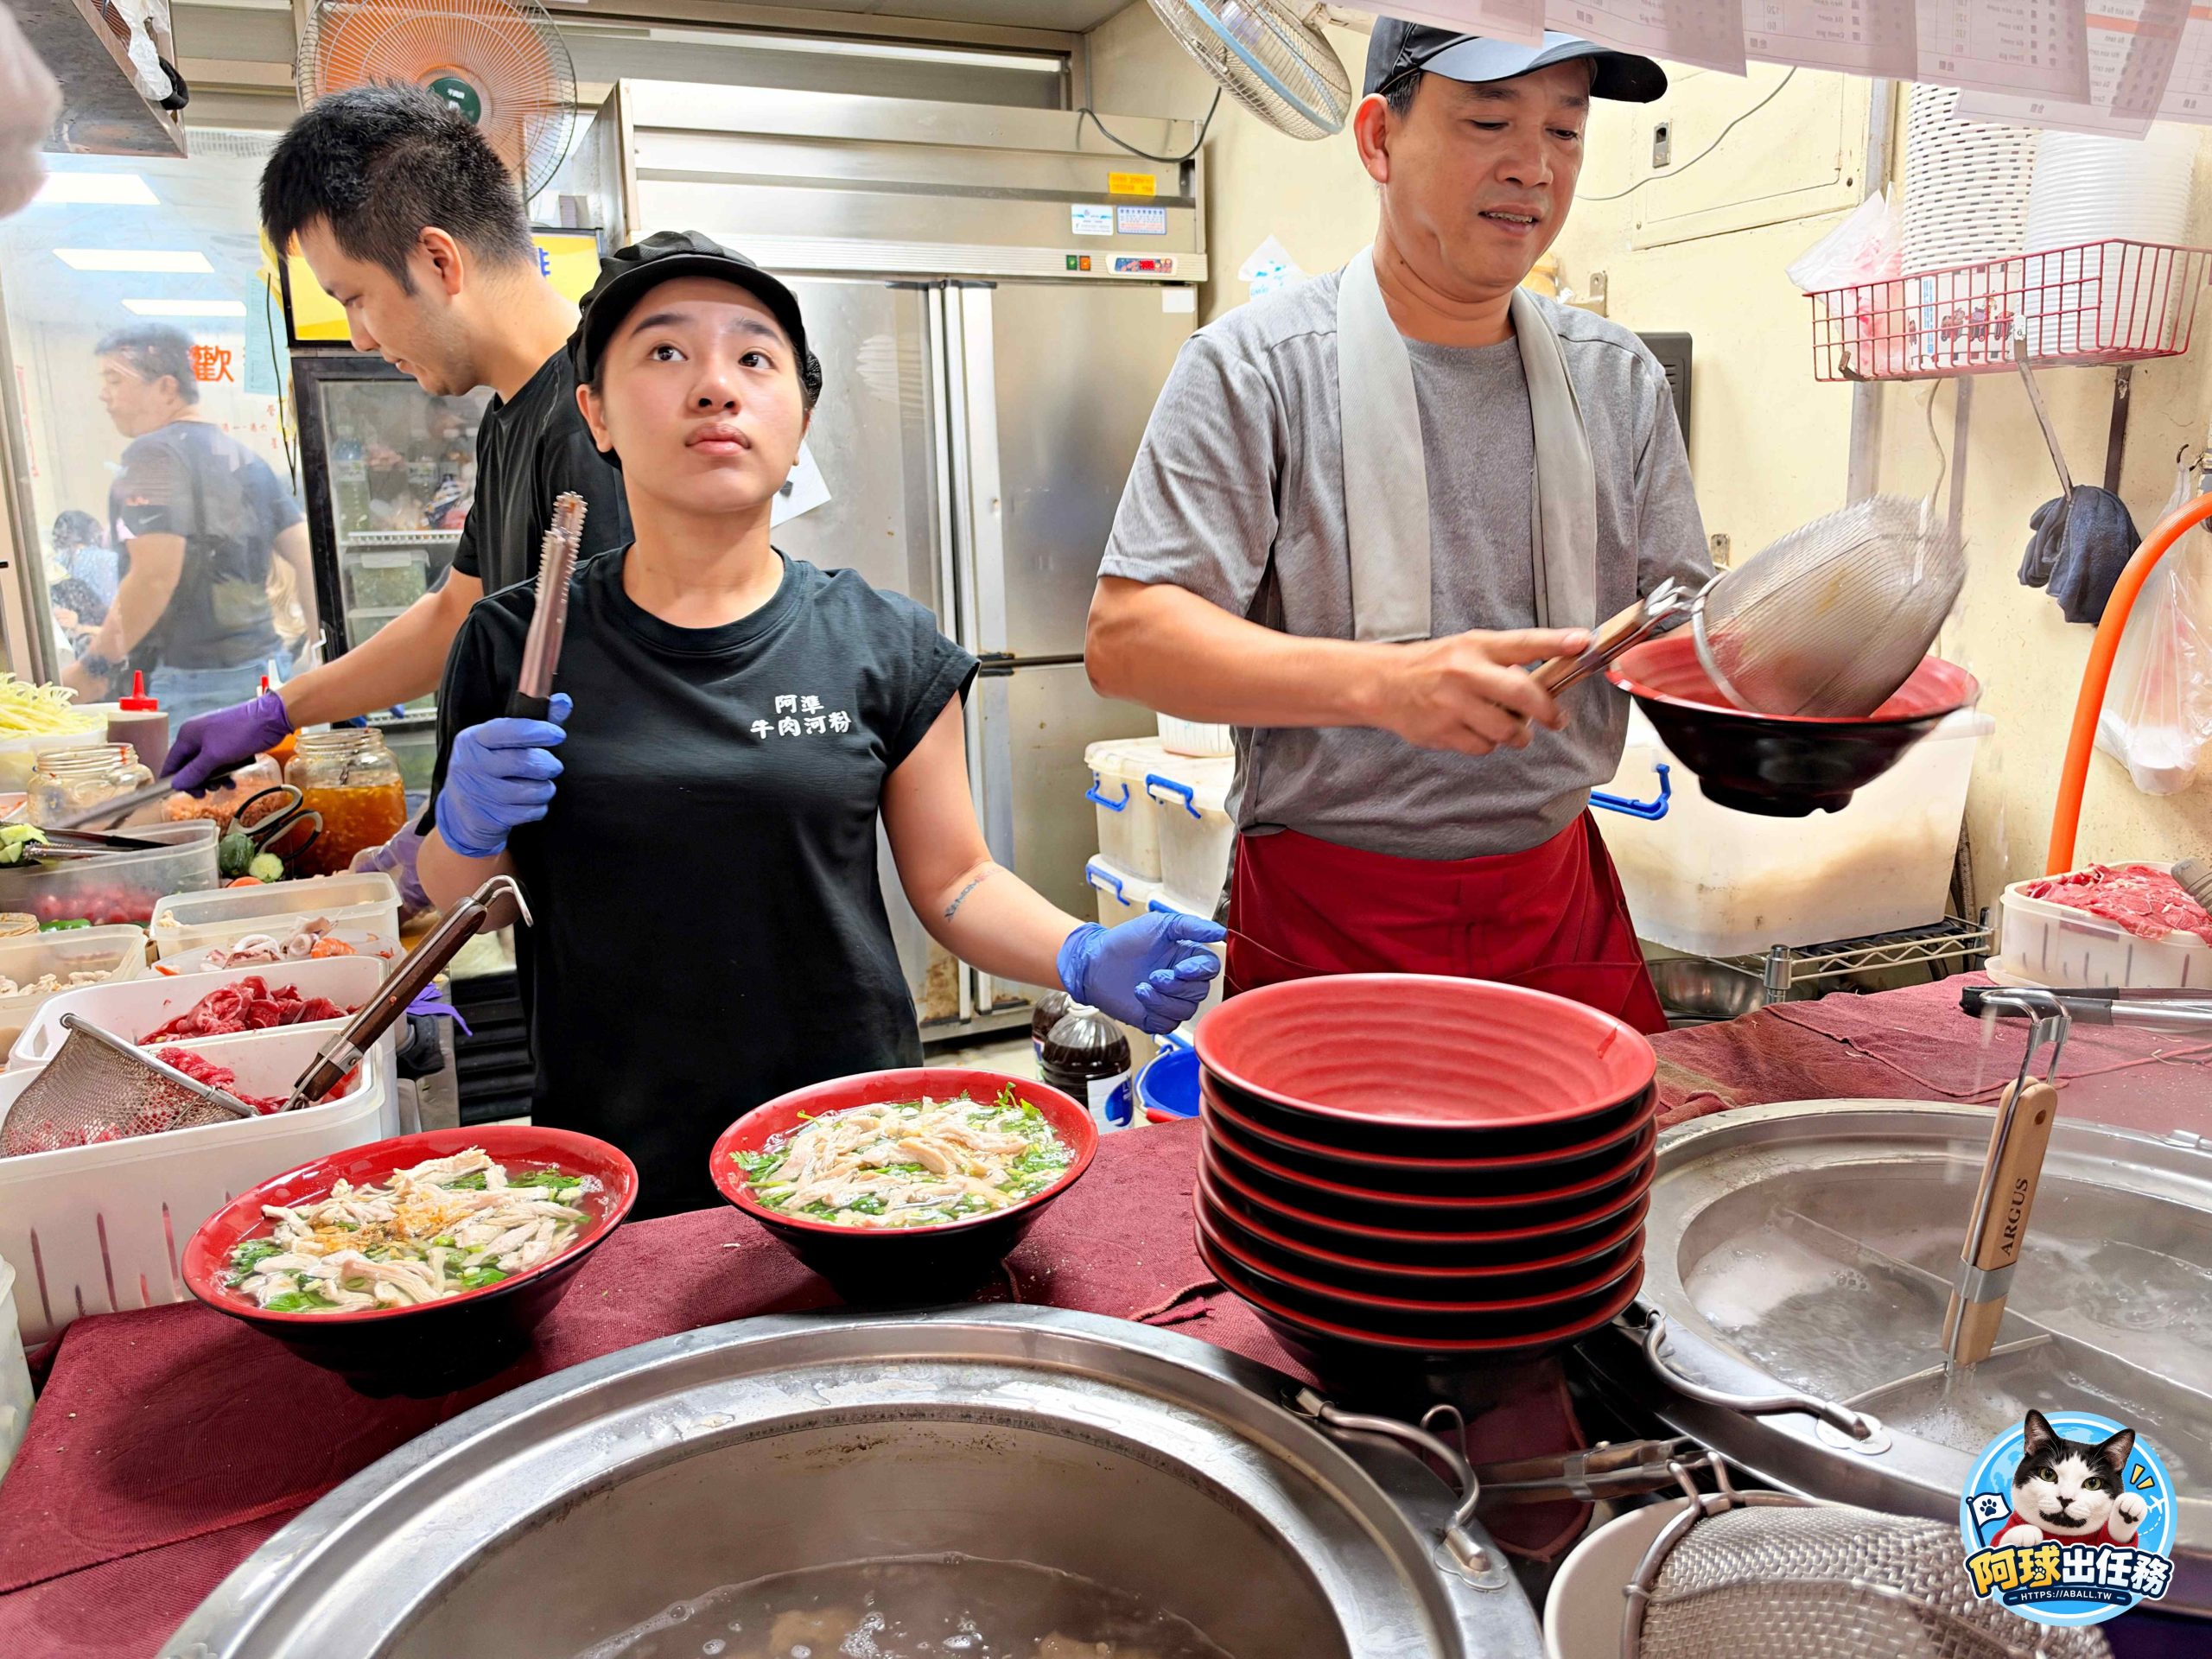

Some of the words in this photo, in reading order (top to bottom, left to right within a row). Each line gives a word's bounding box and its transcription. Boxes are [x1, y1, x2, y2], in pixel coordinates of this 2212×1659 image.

[774, 694, 824, 715] 阿準
[750, 710, 852, 740] 牛肉河粉
[1999, 1178, 2029, 1257] ARGUS
